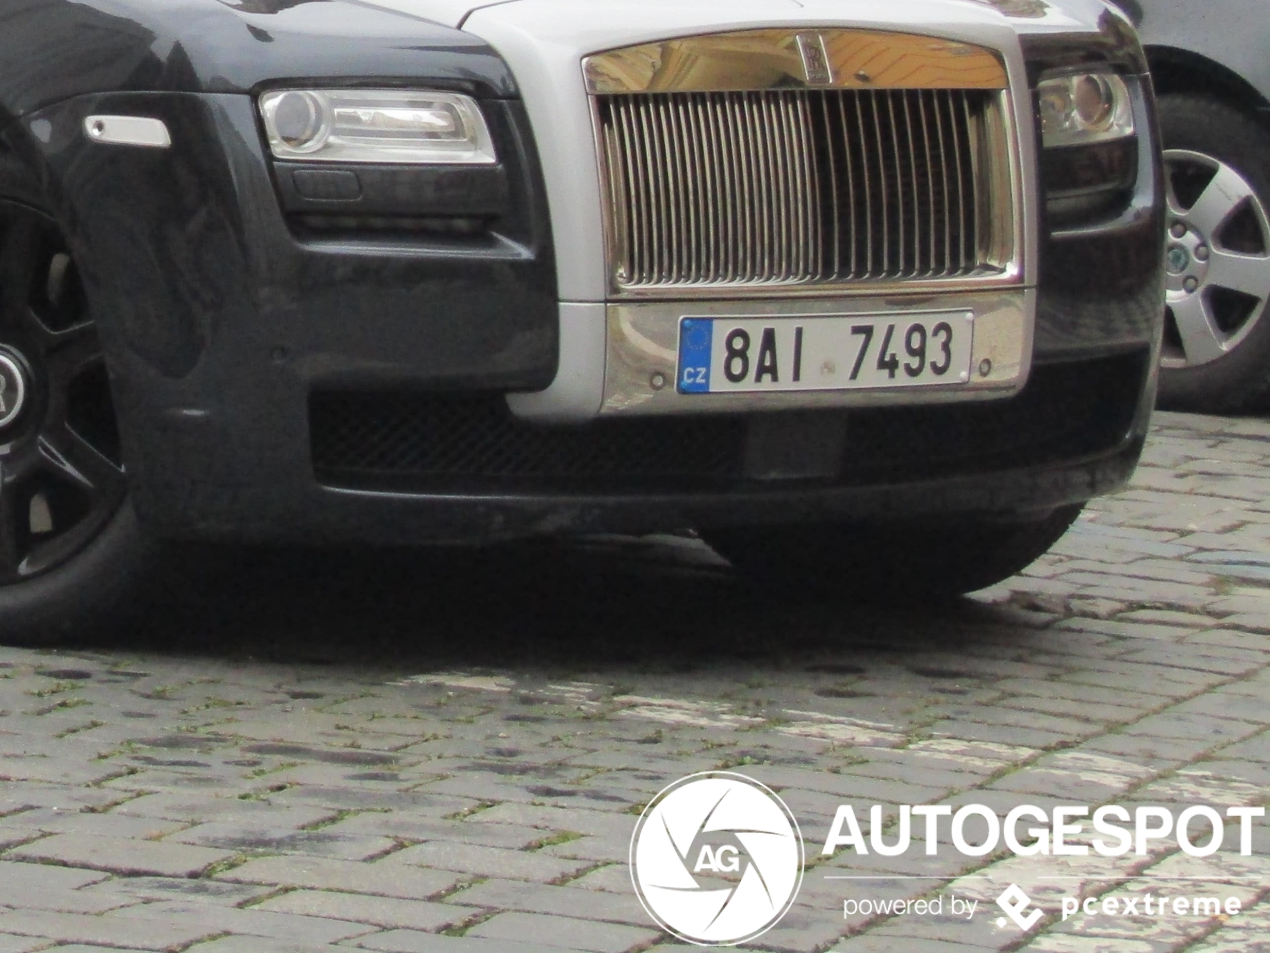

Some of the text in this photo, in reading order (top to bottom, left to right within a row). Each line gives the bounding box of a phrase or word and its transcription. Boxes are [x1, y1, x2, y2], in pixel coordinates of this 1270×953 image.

[723, 321, 954, 383] 8AI 7493
[683, 366, 707, 384] CZ
